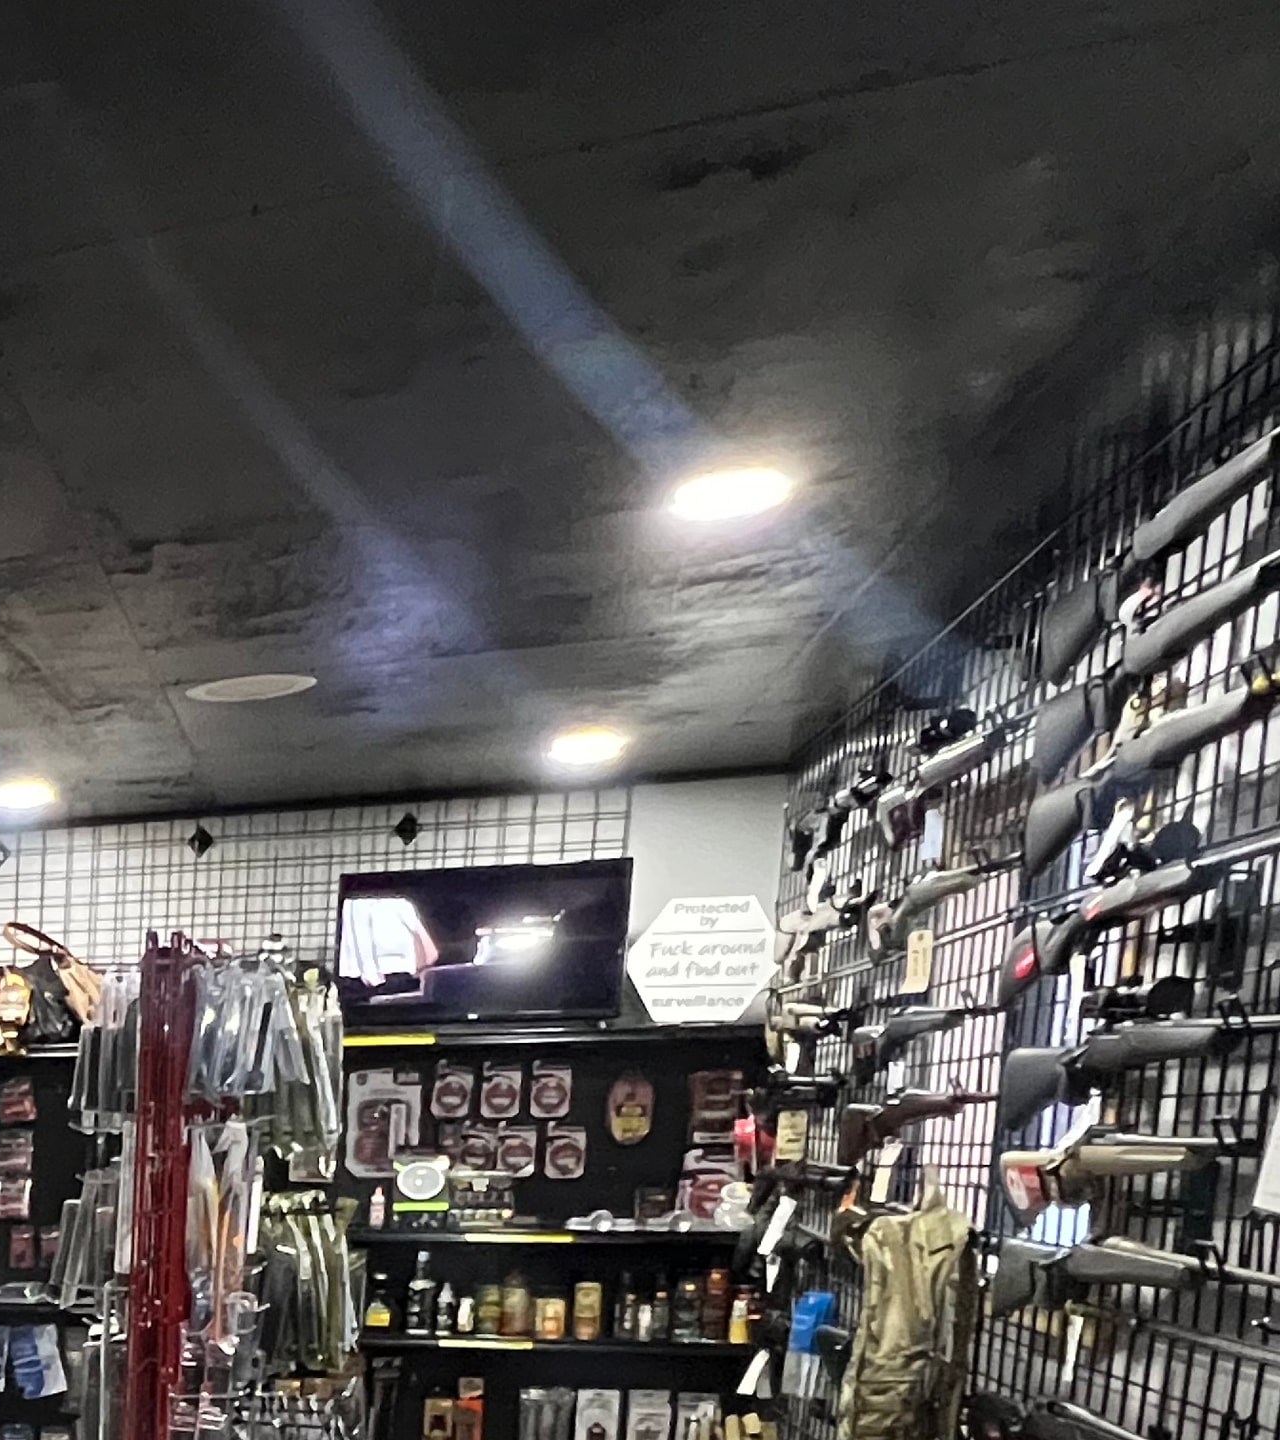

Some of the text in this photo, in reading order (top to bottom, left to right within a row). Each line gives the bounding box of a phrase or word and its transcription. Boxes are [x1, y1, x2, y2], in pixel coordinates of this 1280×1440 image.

[674, 901, 750, 915] Protected
[700, 915, 719, 929] by
[650, 938, 766, 959] Fuck around
[645, 961, 680, 978] and
[725, 962, 759, 977] out
